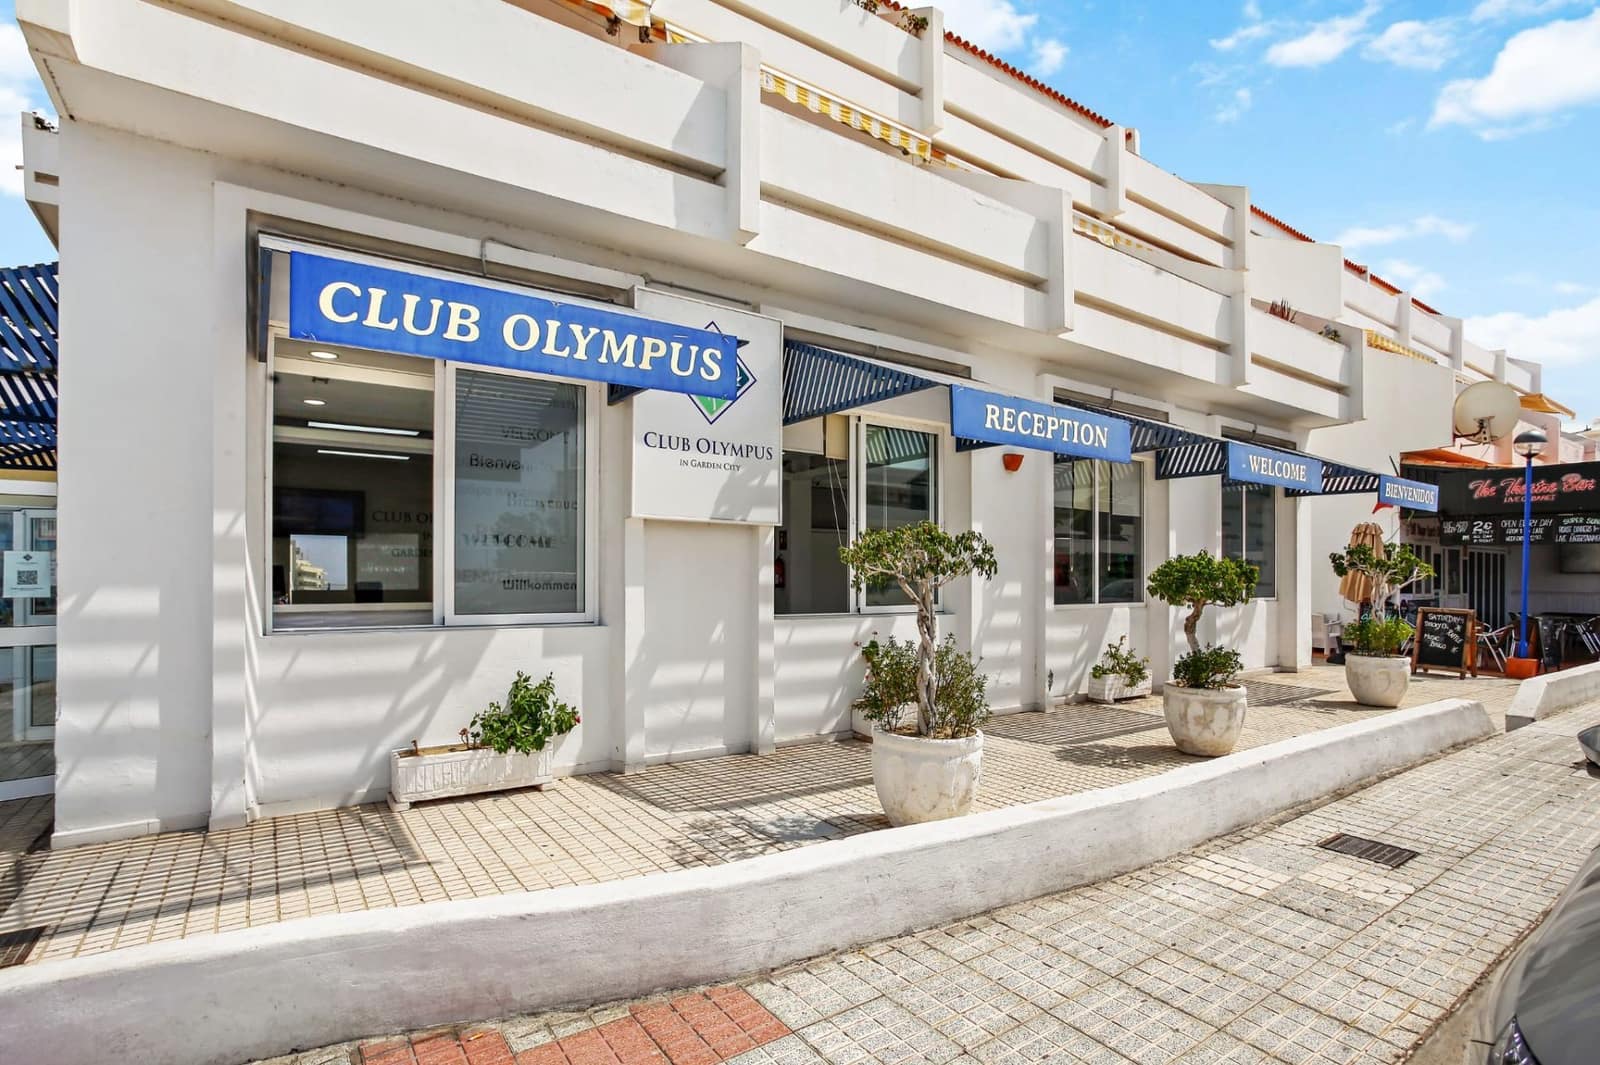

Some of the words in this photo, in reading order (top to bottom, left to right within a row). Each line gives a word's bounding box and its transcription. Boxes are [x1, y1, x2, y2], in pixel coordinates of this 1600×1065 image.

[318, 281, 481, 343] CLUB
[502, 313, 723, 382] OLYMPUS
[985, 404, 1109, 449] RECEPTION
[1248, 454, 1307, 483] WELCOME
[1384, 481, 1436, 505] BIENVENIDOS
[1468, 479, 1498, 500] The
[1561, 472, 1597, 493] Bar
